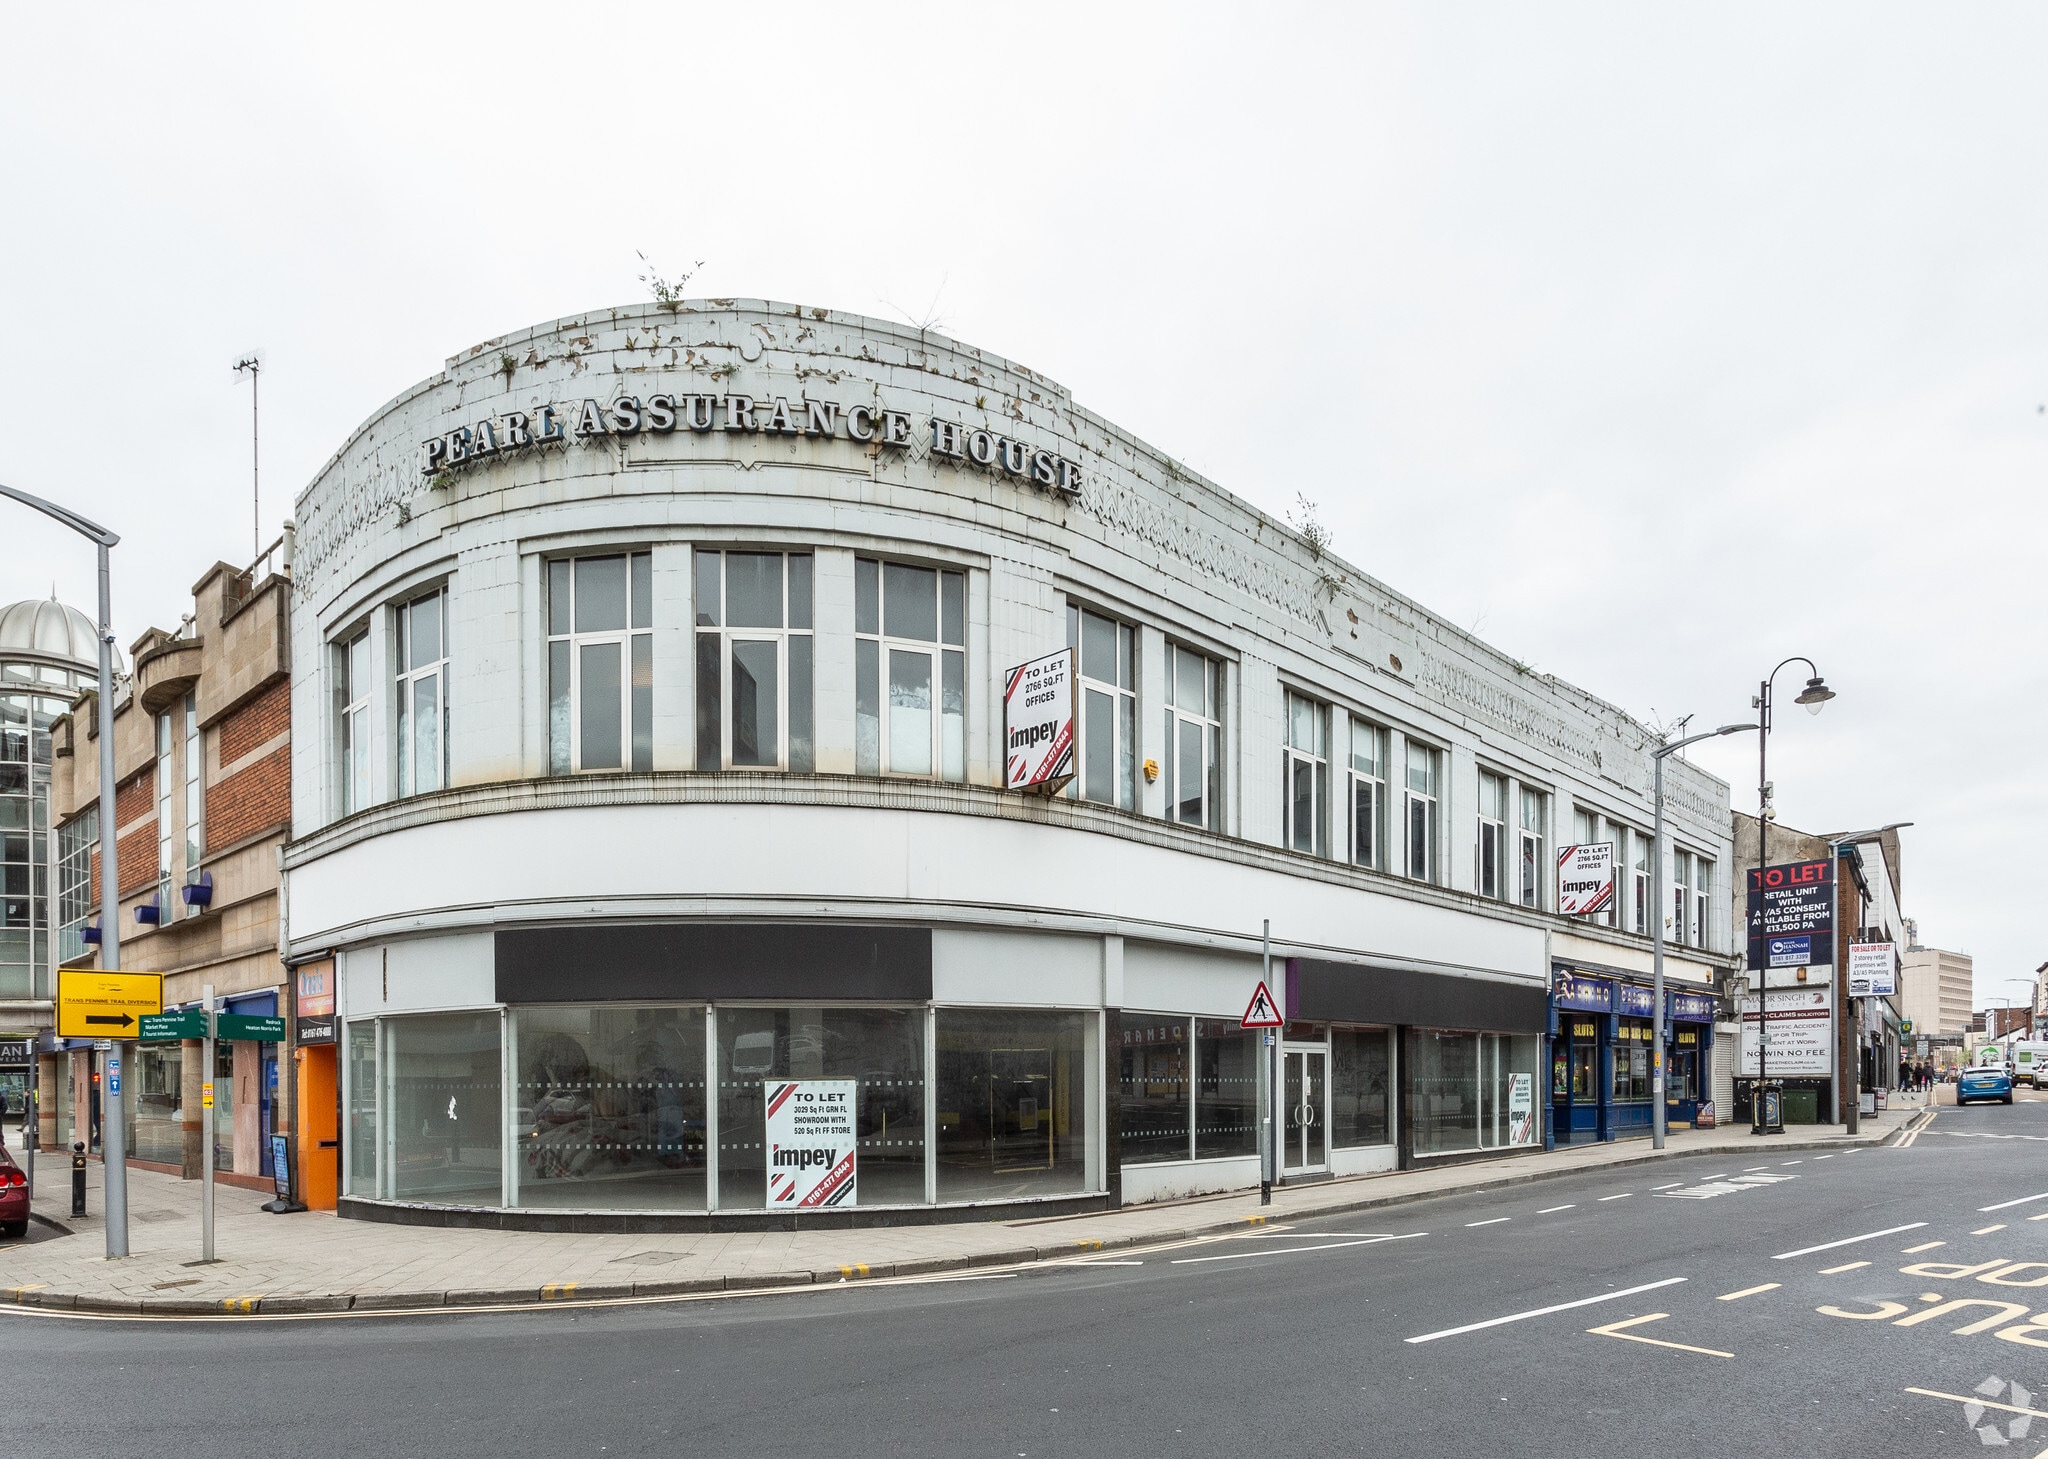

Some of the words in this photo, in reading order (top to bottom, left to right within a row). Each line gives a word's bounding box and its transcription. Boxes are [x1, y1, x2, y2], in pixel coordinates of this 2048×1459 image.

[421, 404, 565, 476] PEARL
[574, 393, 914, 449] ASSURANCE
[931, 416, 1084, 498] HOUSE
[1026, 668, 1040, 679] TO
[1044, 660, 1064, 674] LET
[1026, 680, 1042, 694] 2766
[1044, 673, 1064, 688] SQ.FT
[1026, 690, 1055, 708] OFFICES
[1010, 720, 1058, 749] impey
[1036, 747, 1058, 780] 0161-477
[1055, 730, 1069, 750] 0444
[1753, 868, 1784, 888] TO
[1790, 862, 1828, 884] LET
[1562, 880, 1601, 894] impey
[1764, 890, 1794, 900] RETAIL
[1796, 886, 1818, 896] UNIT
[1778, 897, 1802, 906] WITH
[1755, 908, 1781, 918] A/A5
[1784, 902, 1827, 914] CONSENT
[1803, 911, 1830, 920] FROM
[1766, 922, 1800, 932] £13,500
[1802, 921, 1815, 929] PA
[300, 968, 322, 996] Oasis
[1747, 995, 1775, 1004] MAOR
[1778, 994, 1805, 1002] SINGH
[1574, 1024, 1594, 1036] SLOTS
[1678, 1032, 1696, 1044] SLOTS
[794, 1093, 814, 1102] TO
[819, 1093, 846, 1102] LET
[810, 1106, 817, 1114] Sq
[1511, 1108, 1526, 1123] impey
[806, 1127, 814, 1136] Sq
[773, 1144, 836, 1170] impey
[807, 1175, 836, 1204] 0161-477
[834, 1161, 850, 1178] 0444
